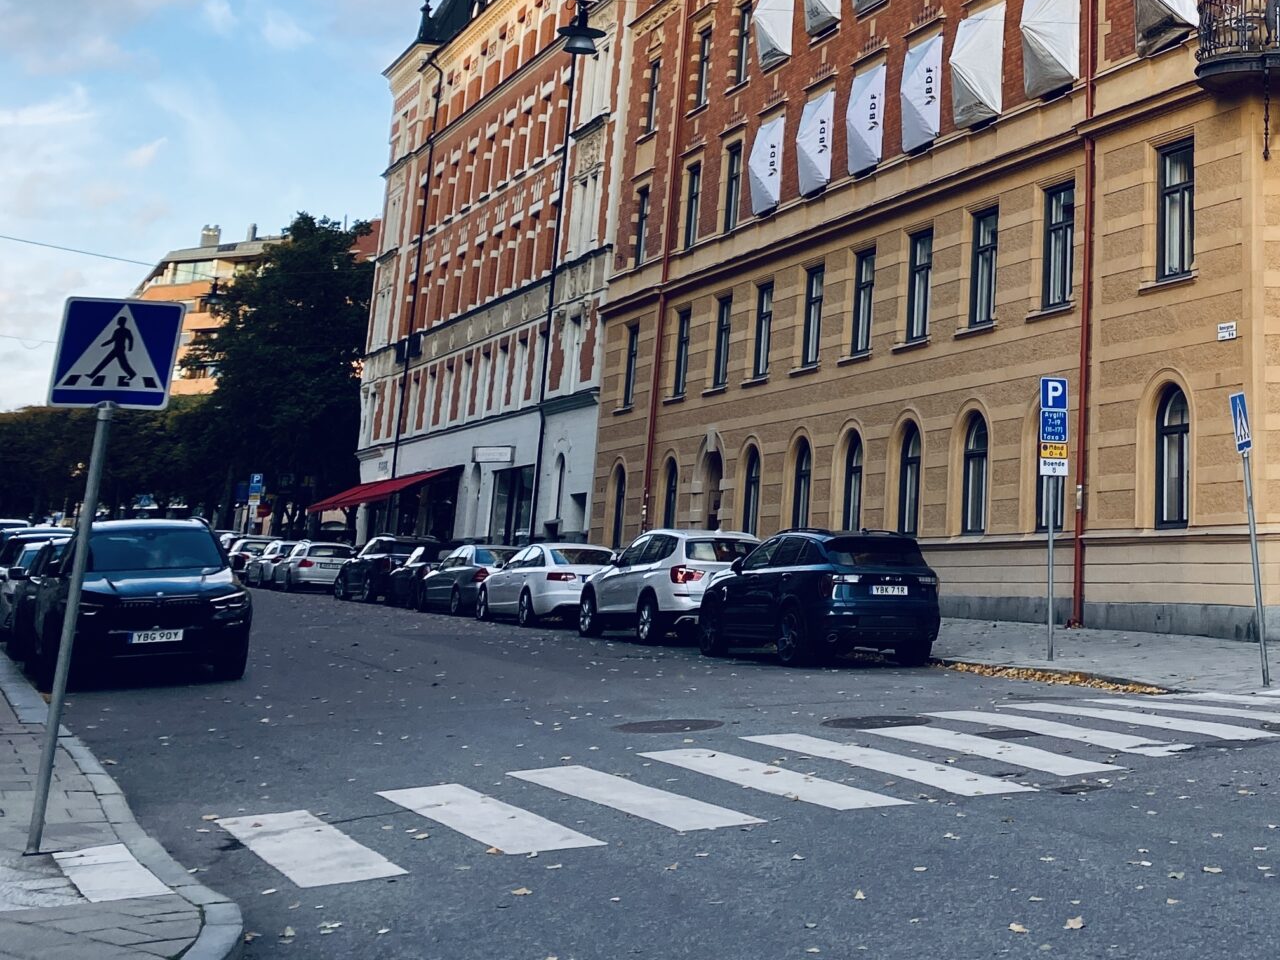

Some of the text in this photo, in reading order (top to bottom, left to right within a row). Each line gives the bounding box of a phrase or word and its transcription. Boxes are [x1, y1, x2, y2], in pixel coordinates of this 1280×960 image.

[1047, 381, 1063, 406] P
[1045, 411, 1064, 419] Avgift
[1043, 460, 1065, 468] Boende
[875, 586, 905, 594] YBK 71R
[136, 632, 157, 642] YBG
